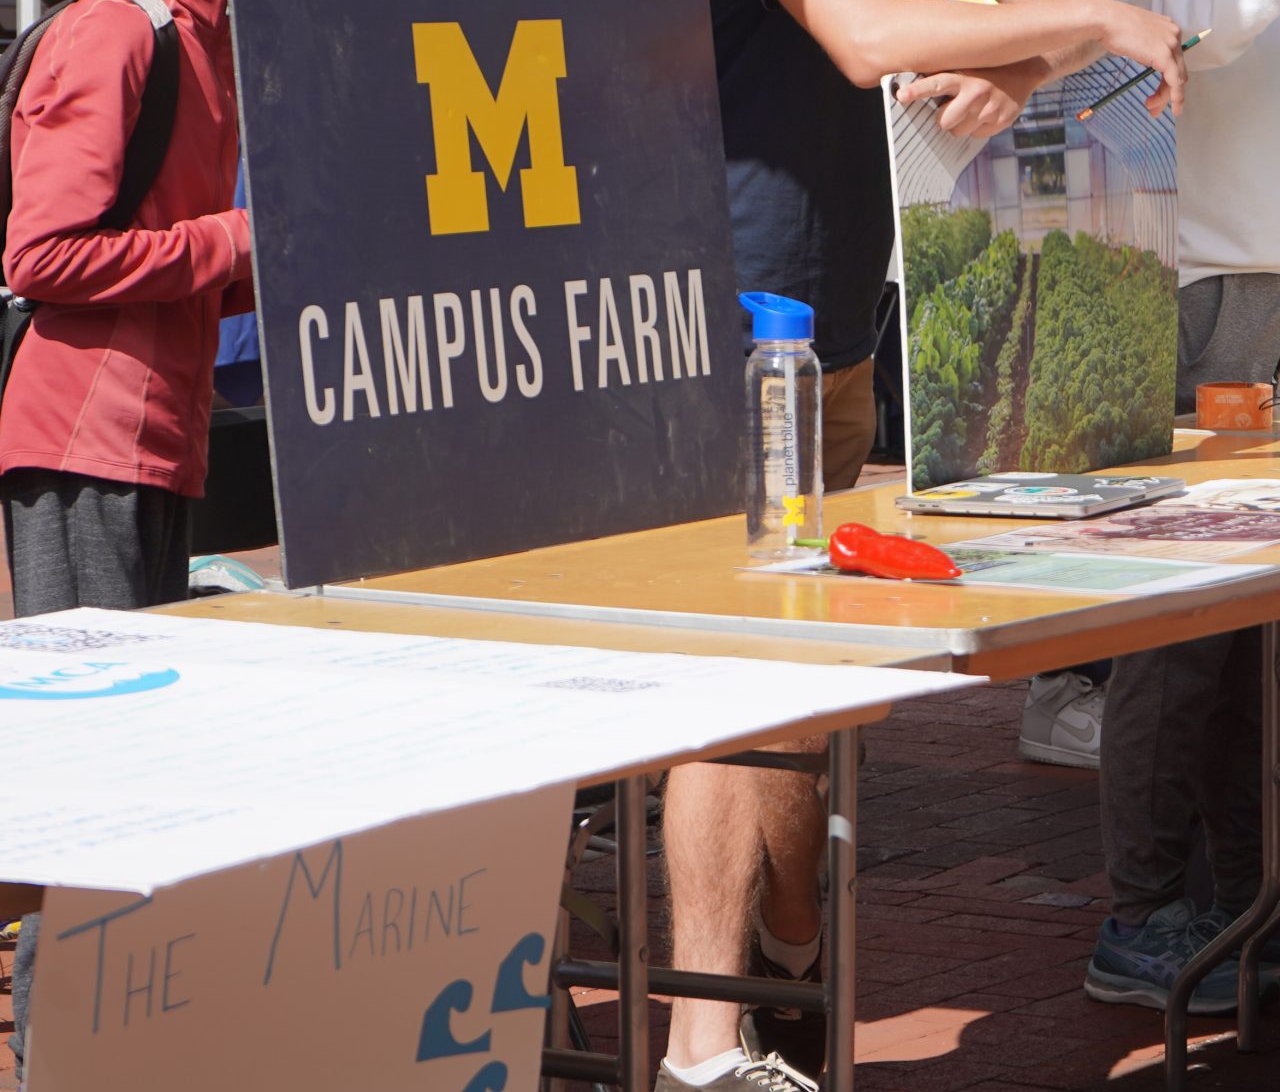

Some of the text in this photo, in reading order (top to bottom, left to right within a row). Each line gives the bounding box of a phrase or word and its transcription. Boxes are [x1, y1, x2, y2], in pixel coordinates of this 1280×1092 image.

[411, 18, 581, 236] M
[297, 269, 712, 426] CAMPUS FARM
[781, 412, 794, 442] blue
[782, 445, 797, 487] planet
[57, 839, 489, 1033] THE MARINE
